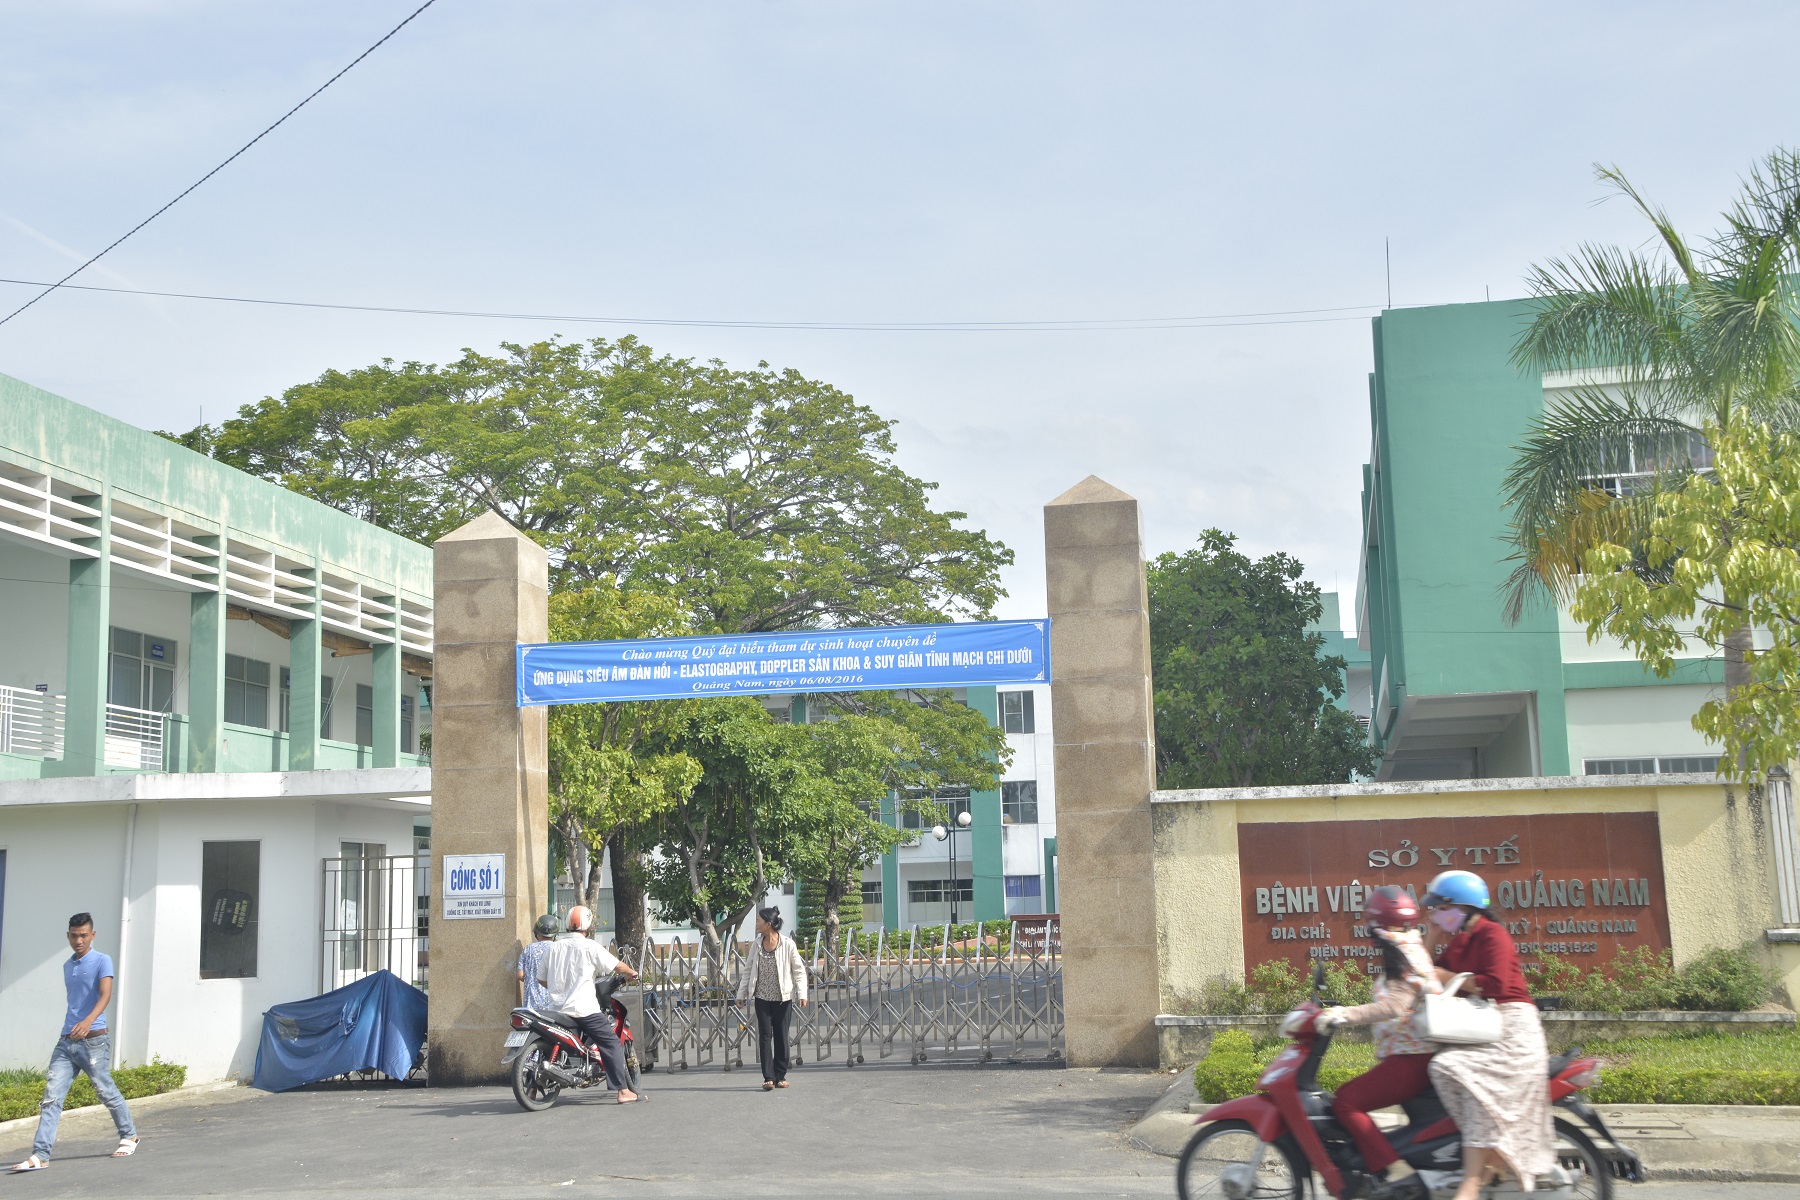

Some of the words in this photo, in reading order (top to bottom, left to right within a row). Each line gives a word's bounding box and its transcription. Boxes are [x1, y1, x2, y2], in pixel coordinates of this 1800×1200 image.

[621, 648, 652, 660] Chào
[654, 647, 688, 660] mừng
[691, 645, 716, 659] Quý
[718, 643, 738, 657] đại
[767, 641, 798, 653] tham
[799, 639, 817, 654] dự
[818, 638, 844, 651] sinh
[847, 637, 875, 652] hoạt
[876, 635, 920, 650] chuyên
[533, 669, 555, 686] ỨNG
[556, 669, 584, 687] DỤNG
[586, 666, 610, 683] SIÊU
[611, 665, 629, 682] ÂM
[629, 664, 652, 681] ĐÀN
[653, 660, 671, 680] HỒI
[680, 660, 758, 678] ELASTOGRAPHY,
[760, 657, 806, 674] DOPPLER
[808, 653, 830, 672] SẢN
[832, 655, 861, 671] KHOA
[863, 655, 872, 670] &
[874, 654, 895, 670] SUY
[897, 650, 923, 668] GIÃN
[925, 650, 950, 668] TĨNH
[952, 650, 984, 669] MẠCH
[986, 649, 1005, 666] CHI
[1007, 646, 1033, 664] DƯỚI
[734, 679, 765, 688] Nam,
[768, 677, 797, 687] ngày
[799, 674, 864, 686] 06/08/2016
[1368, 839, 1419, 868] SỞ
[1430, 847, 1458, 866] Y
[1464, 834, 1521, 865] TẾ
[450, 861, 477, 891] CỔNG
[479, 861, 492, 891] SỐ
[494, 868, 499, 890] 1
[1255, 880, 1320, 921] BỆNH
[1497, 869, 1586, 910] QUẢNG
[1592, 878, 1651, 907] NAM
[1271, 926, 1297, 943] ĐỊA
[1509, 917, 1532, 935] KỲ
[1546, 916, 1599, 935] QUẢNG
[1602, 919, 1638, 933] NAM
[1309, 943, 1339, 961] ĐIỆN
[1543, 940, 1598, 954] 3851523
